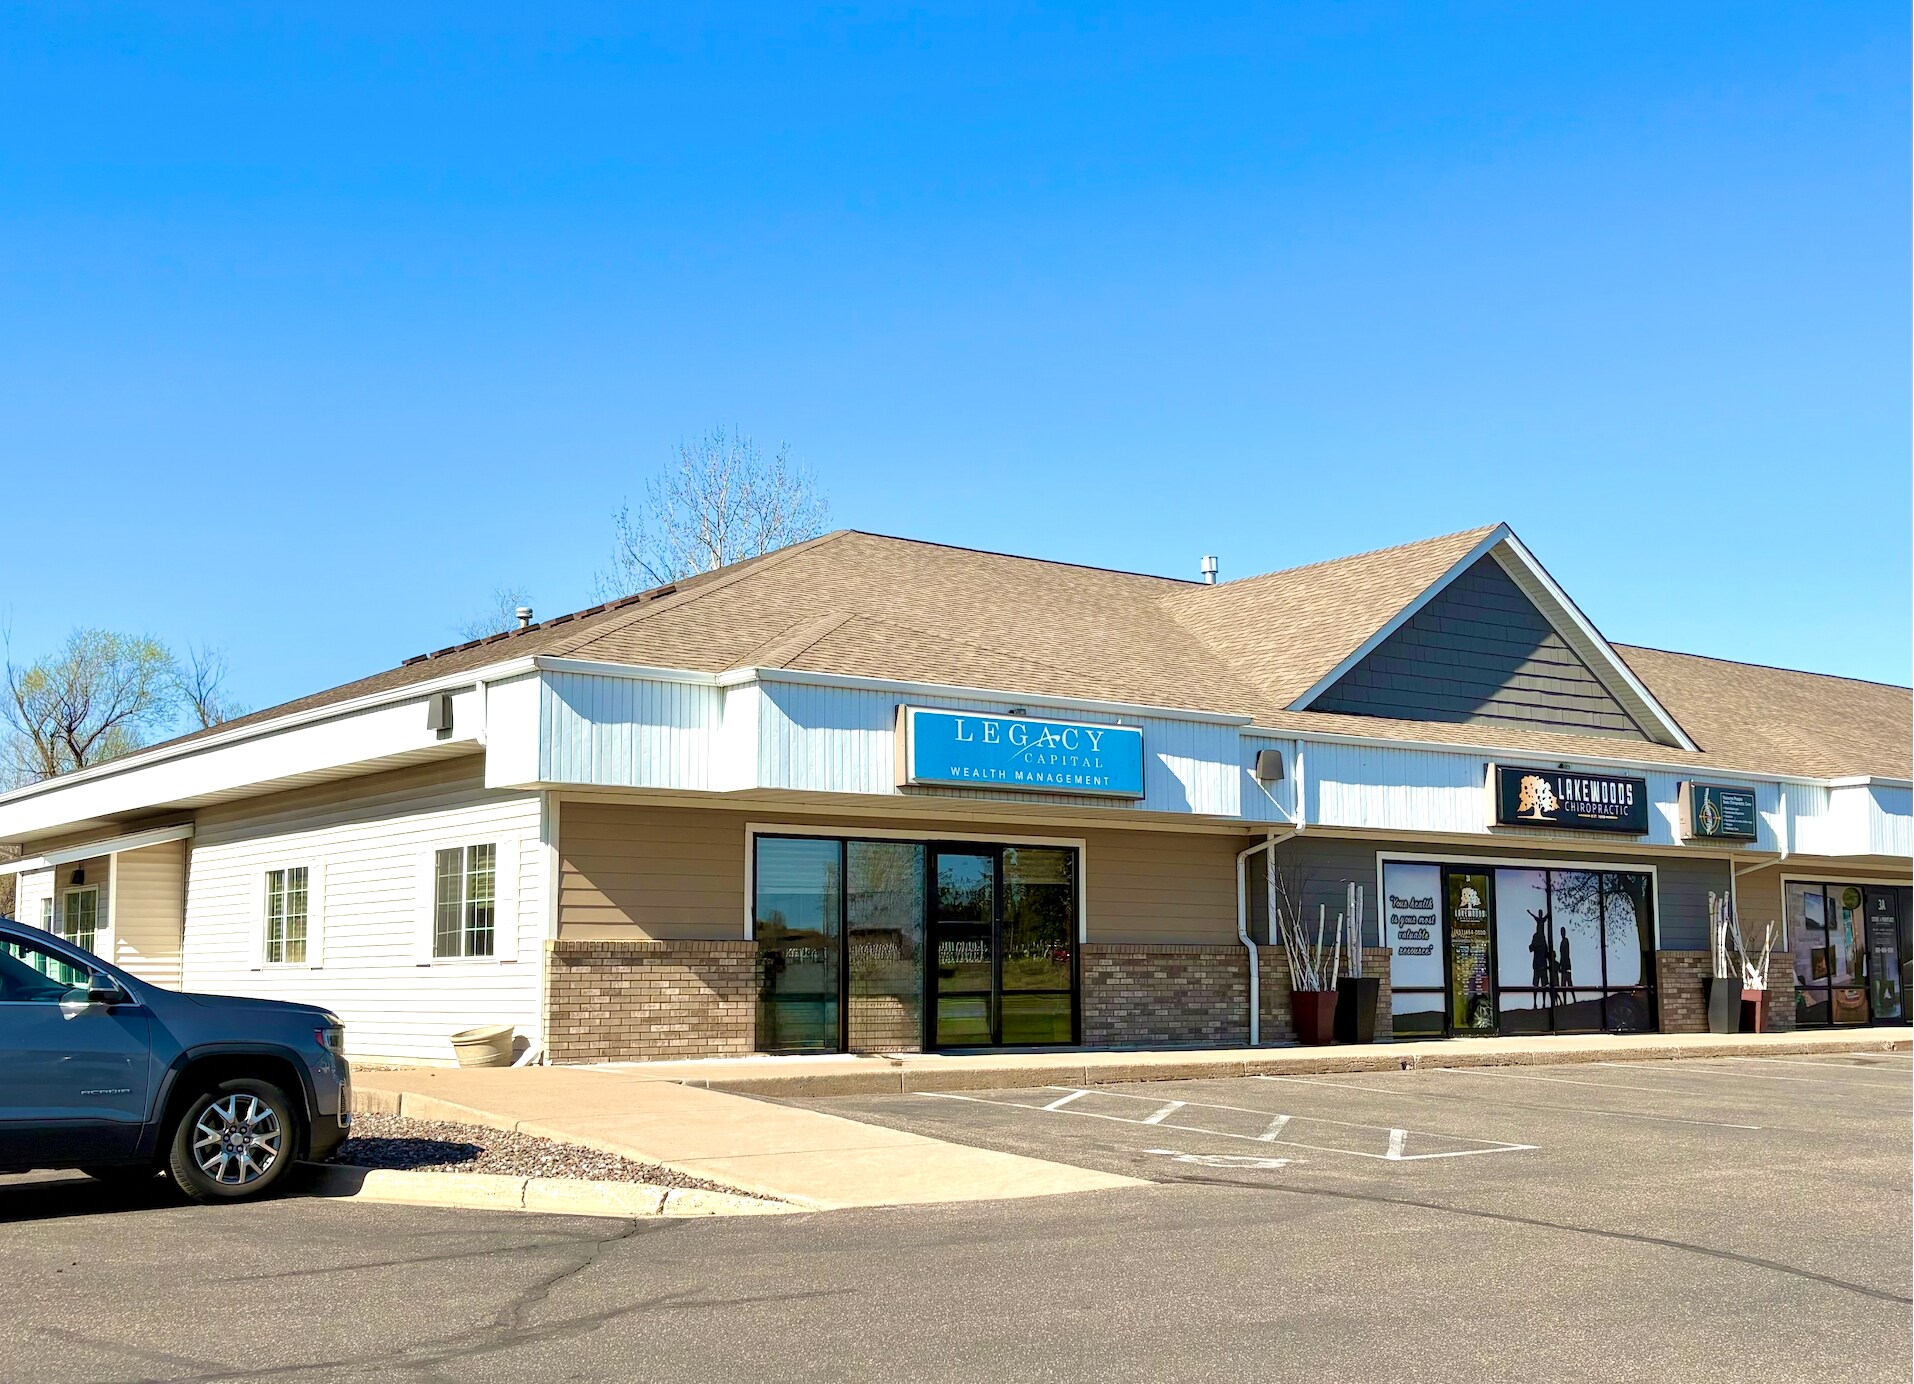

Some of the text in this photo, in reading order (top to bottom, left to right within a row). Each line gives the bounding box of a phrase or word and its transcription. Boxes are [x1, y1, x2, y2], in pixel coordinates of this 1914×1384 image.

[954, 719, 1104, 752] LEGACY
[1024, 752, 1103, 769] CAPITAL
[950, 766, 1109, 786] WEALTH MANAGEMENT
[1557, 778, 1634, 806] LAKEWOODS
[1564, 801, 1629, 815] CHIROPRACTIC
[1409, 896, 1433, 910] health
[1391, 913, 1436, 929] is your most
[1398, 928, 1430, 941] valuable
